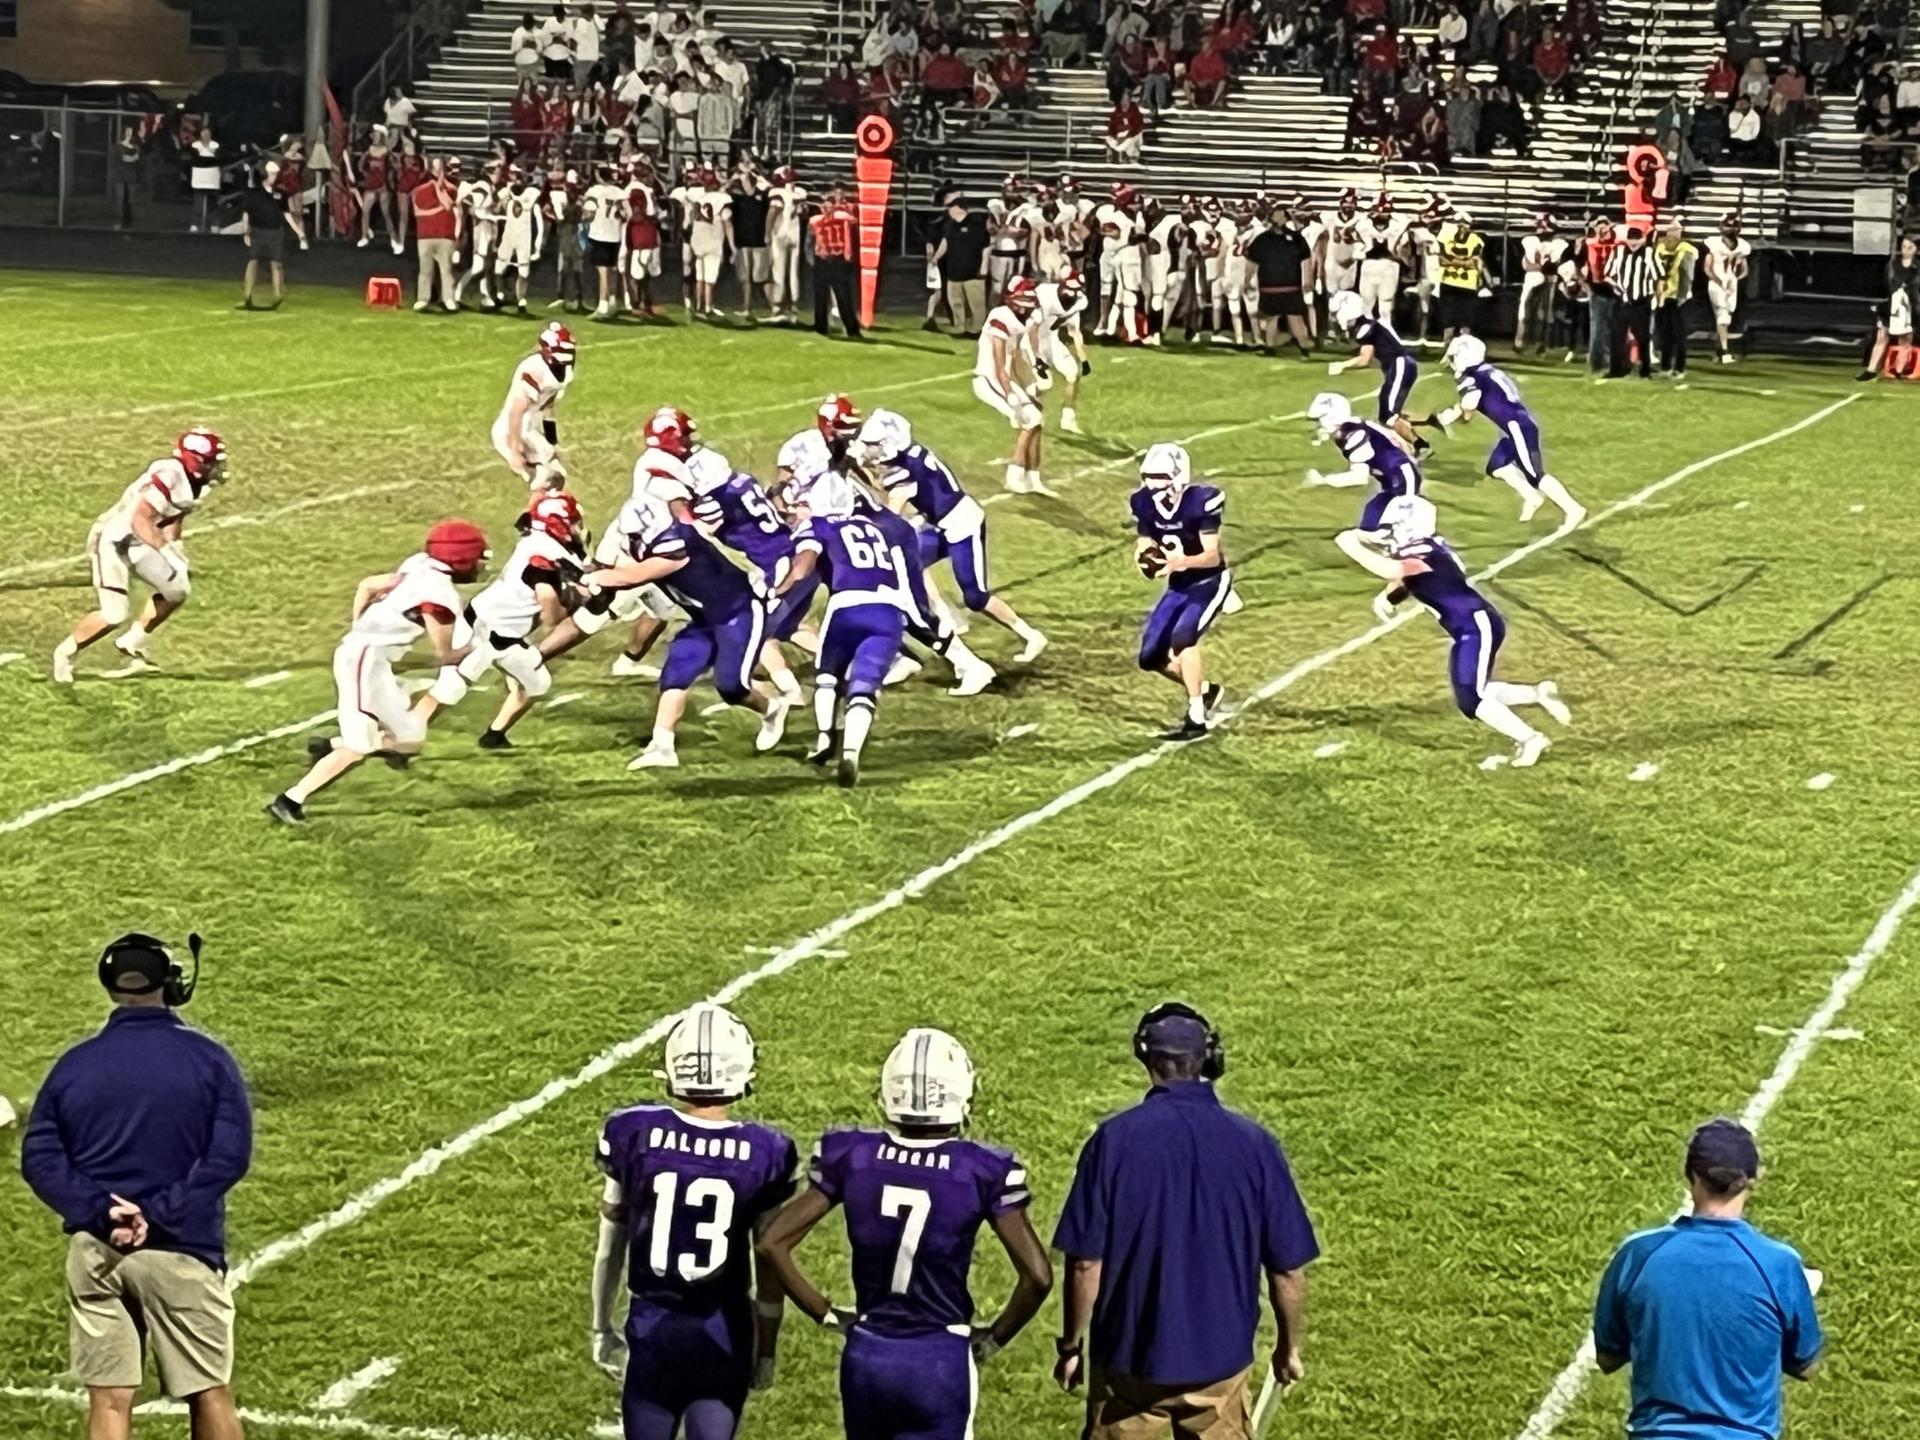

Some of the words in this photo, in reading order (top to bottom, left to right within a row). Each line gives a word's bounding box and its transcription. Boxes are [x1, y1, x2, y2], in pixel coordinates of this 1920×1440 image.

[840, 523, 894, 571] 62
[650, 1171, 735, 1282] 13
[880, 1184, 932, 1295] 7
